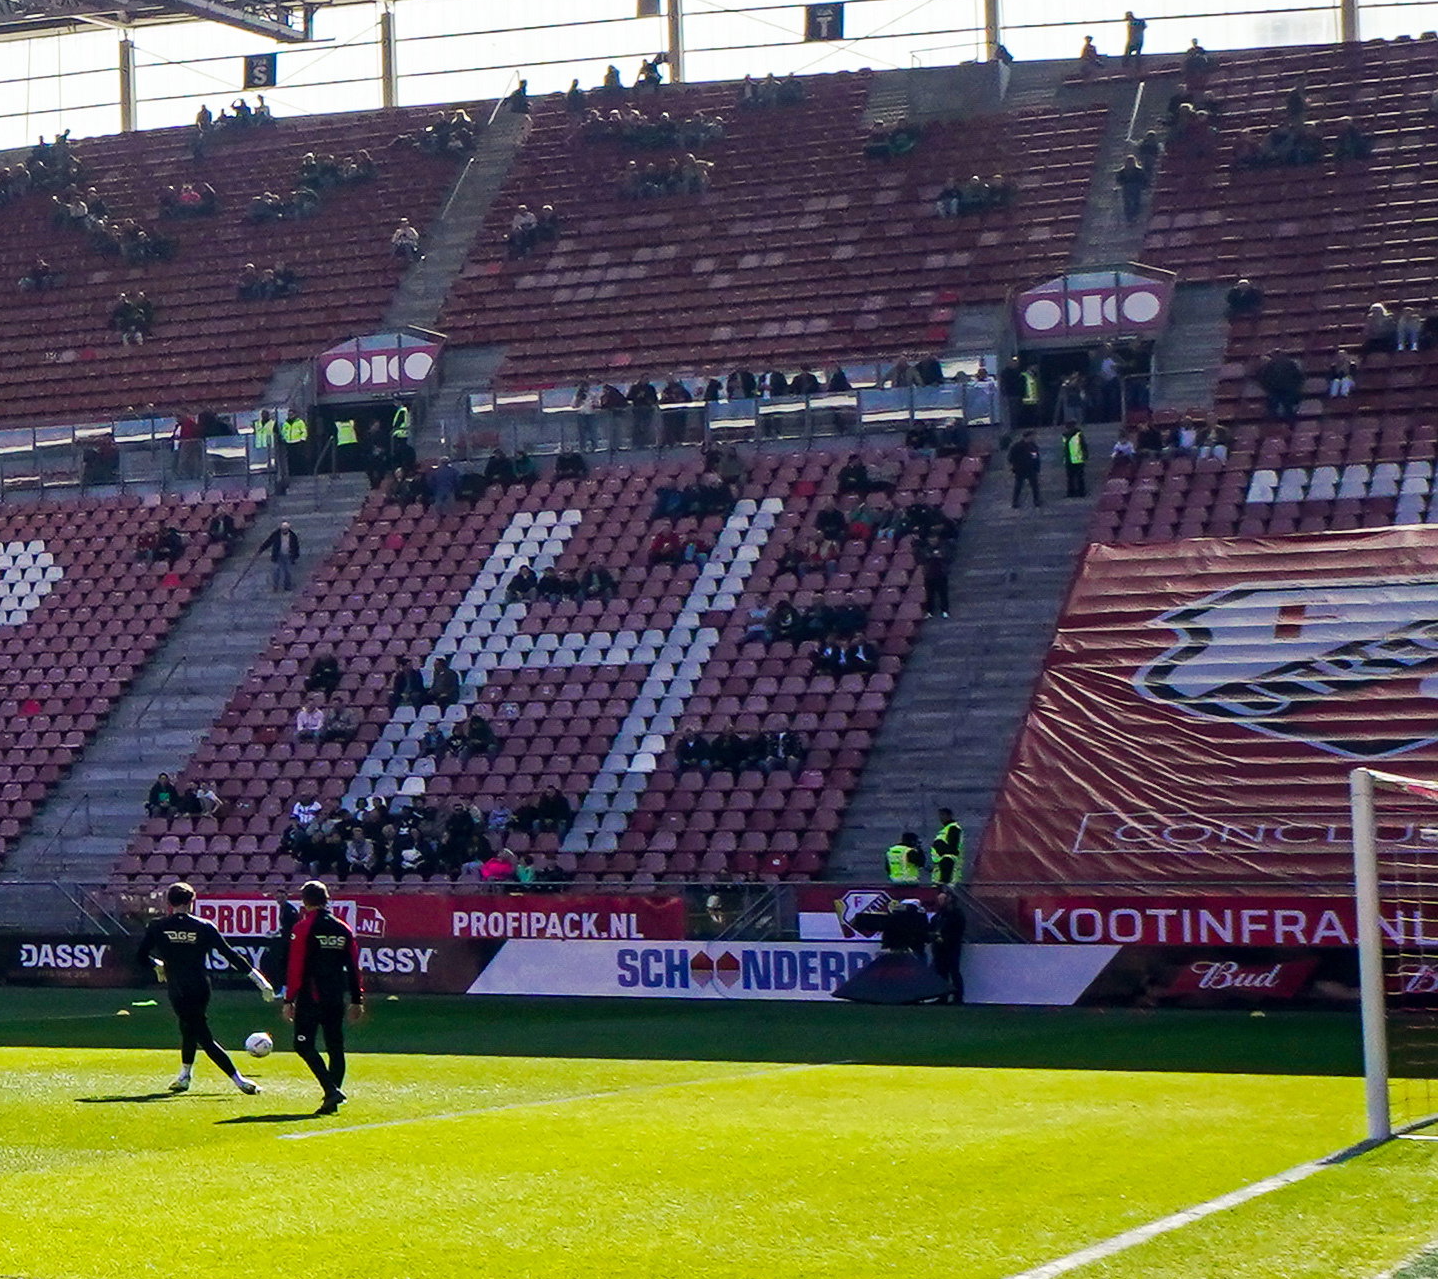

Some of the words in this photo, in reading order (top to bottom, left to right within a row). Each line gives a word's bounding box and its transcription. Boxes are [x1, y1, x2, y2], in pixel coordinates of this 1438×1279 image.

[452, 911, 646, 940] PROFIPACK.NL
[19, 943, 108, 969] DASSY
[358, 947, 434, 974] ASSY
[1191, 960, 1284, 990] Bud
